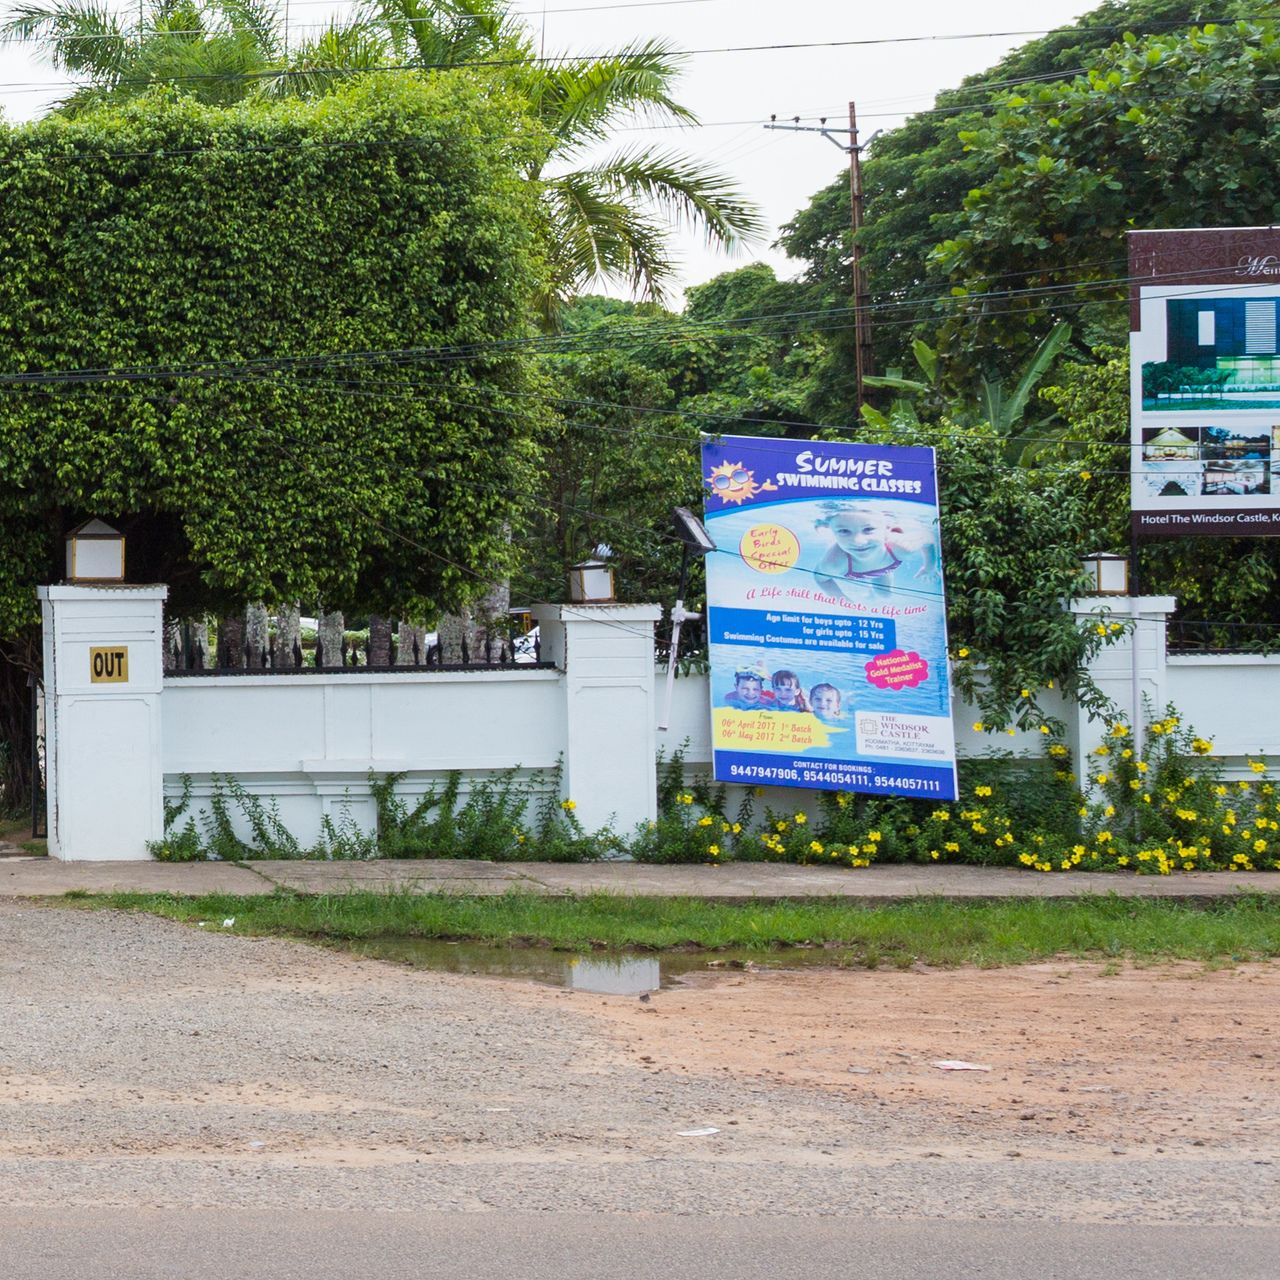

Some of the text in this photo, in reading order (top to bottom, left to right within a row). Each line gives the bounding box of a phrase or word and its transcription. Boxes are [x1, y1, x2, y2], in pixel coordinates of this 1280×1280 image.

[776, 473, 922, 494] SWIMMING CLASSES
[1141, 514, 1169, 524] Hotel
[1170, 514, 1190, 523] The
[1192, 513, 1235, 523] Windsor
[1237, 513, 1271, 523] Castle,
[814, 592, 836, 605] that
[839, 597, 867, 612] lasts
[766, 613, 781, 623] Age
[782, 614, 800, 623] limit
[802, 615, 812, 624] for
[814, 616, 833, 626] boys
[858, 620, 868, 628] 12
[869, 621, 883, 629] Yrs
[802, 627, 813, 635] for
[815, 628, 833, 637] girls
[859, 630, 868, 638] 15
[870, 631, 884, 639] Yrs
[724, 632, 885, 651] Swimming Costumes are available for sale
[93, 652, 124, 677] OUT
[876, 655, 909, 667] National
[870, 667, 889, 678] Gold
[884, 673, 913, 684] Trainer
[737, 720, 755, 729] April
[756, 721, 776, 730] 2017
[880, 722, 929, 734] WINDSOR
[755, 732, 775, 741] 2017
[793, 761, 823, 770] CONTACT
[824, 762, 837, 771] FOR
[730, 764, 940, 791] 9447947906, 9544054111, 9544057111
